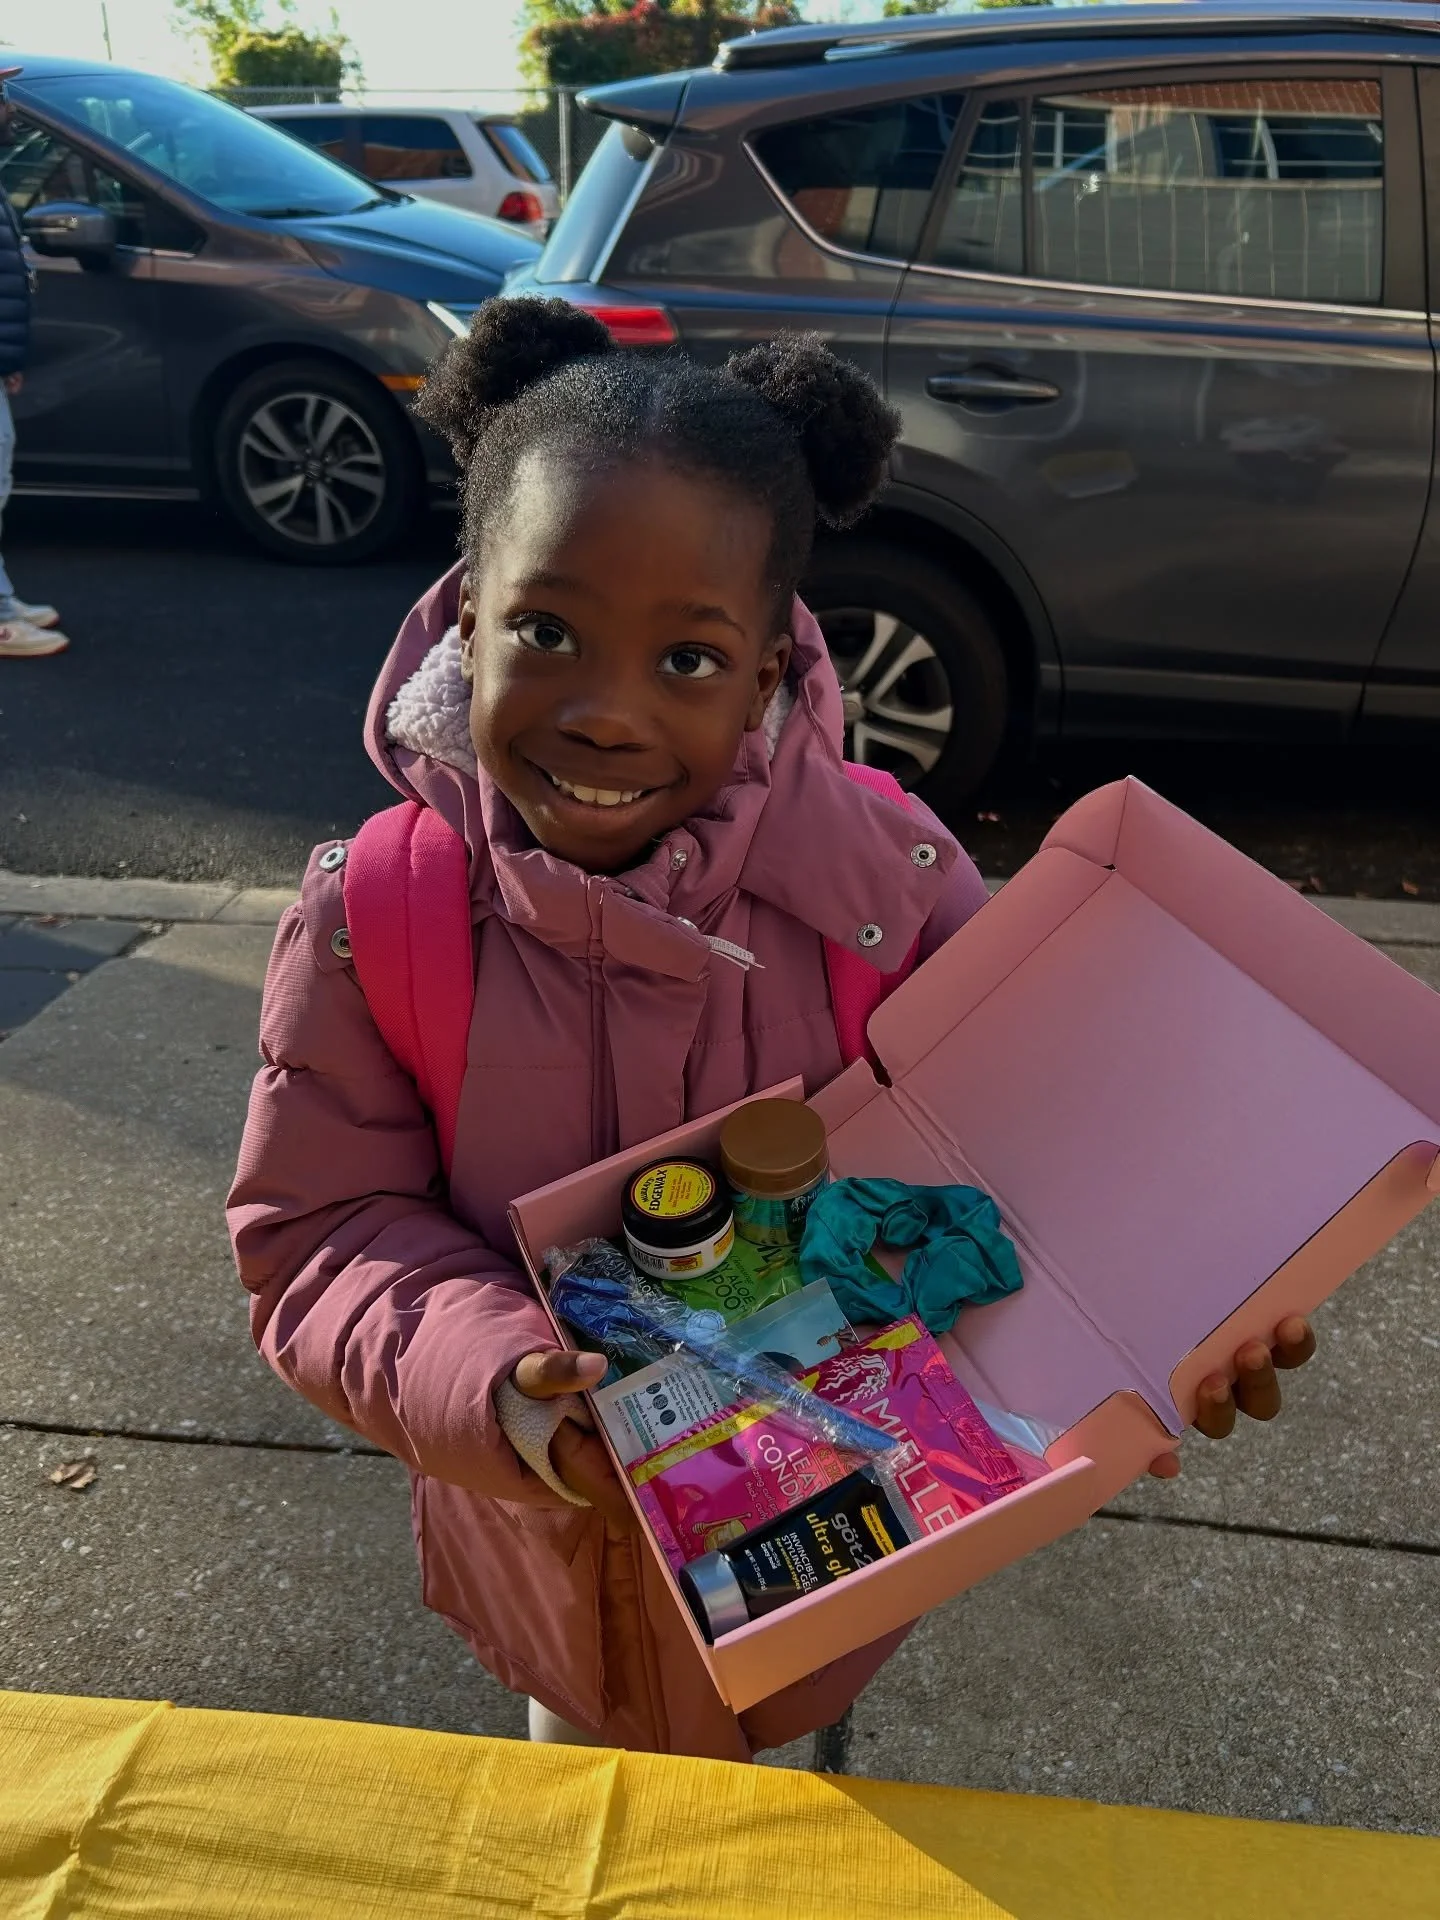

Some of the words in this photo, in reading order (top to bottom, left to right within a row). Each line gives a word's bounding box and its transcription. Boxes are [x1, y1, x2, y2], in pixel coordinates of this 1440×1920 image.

[648, 1169, 668, 1211] EDGEWAX
[725, 1271, 756, 1306] ALOE
[862, 1397, 959, 1534] MIELLE
[780, 1533, 804, 1574] STYLING
[798, 1572, 812, 1593] GEL
[789, 1530, 817, 1584] INVINCIBLE
[804, 1508, 841, 1555] ultra
[824, 1554, 852, 1581] gl
